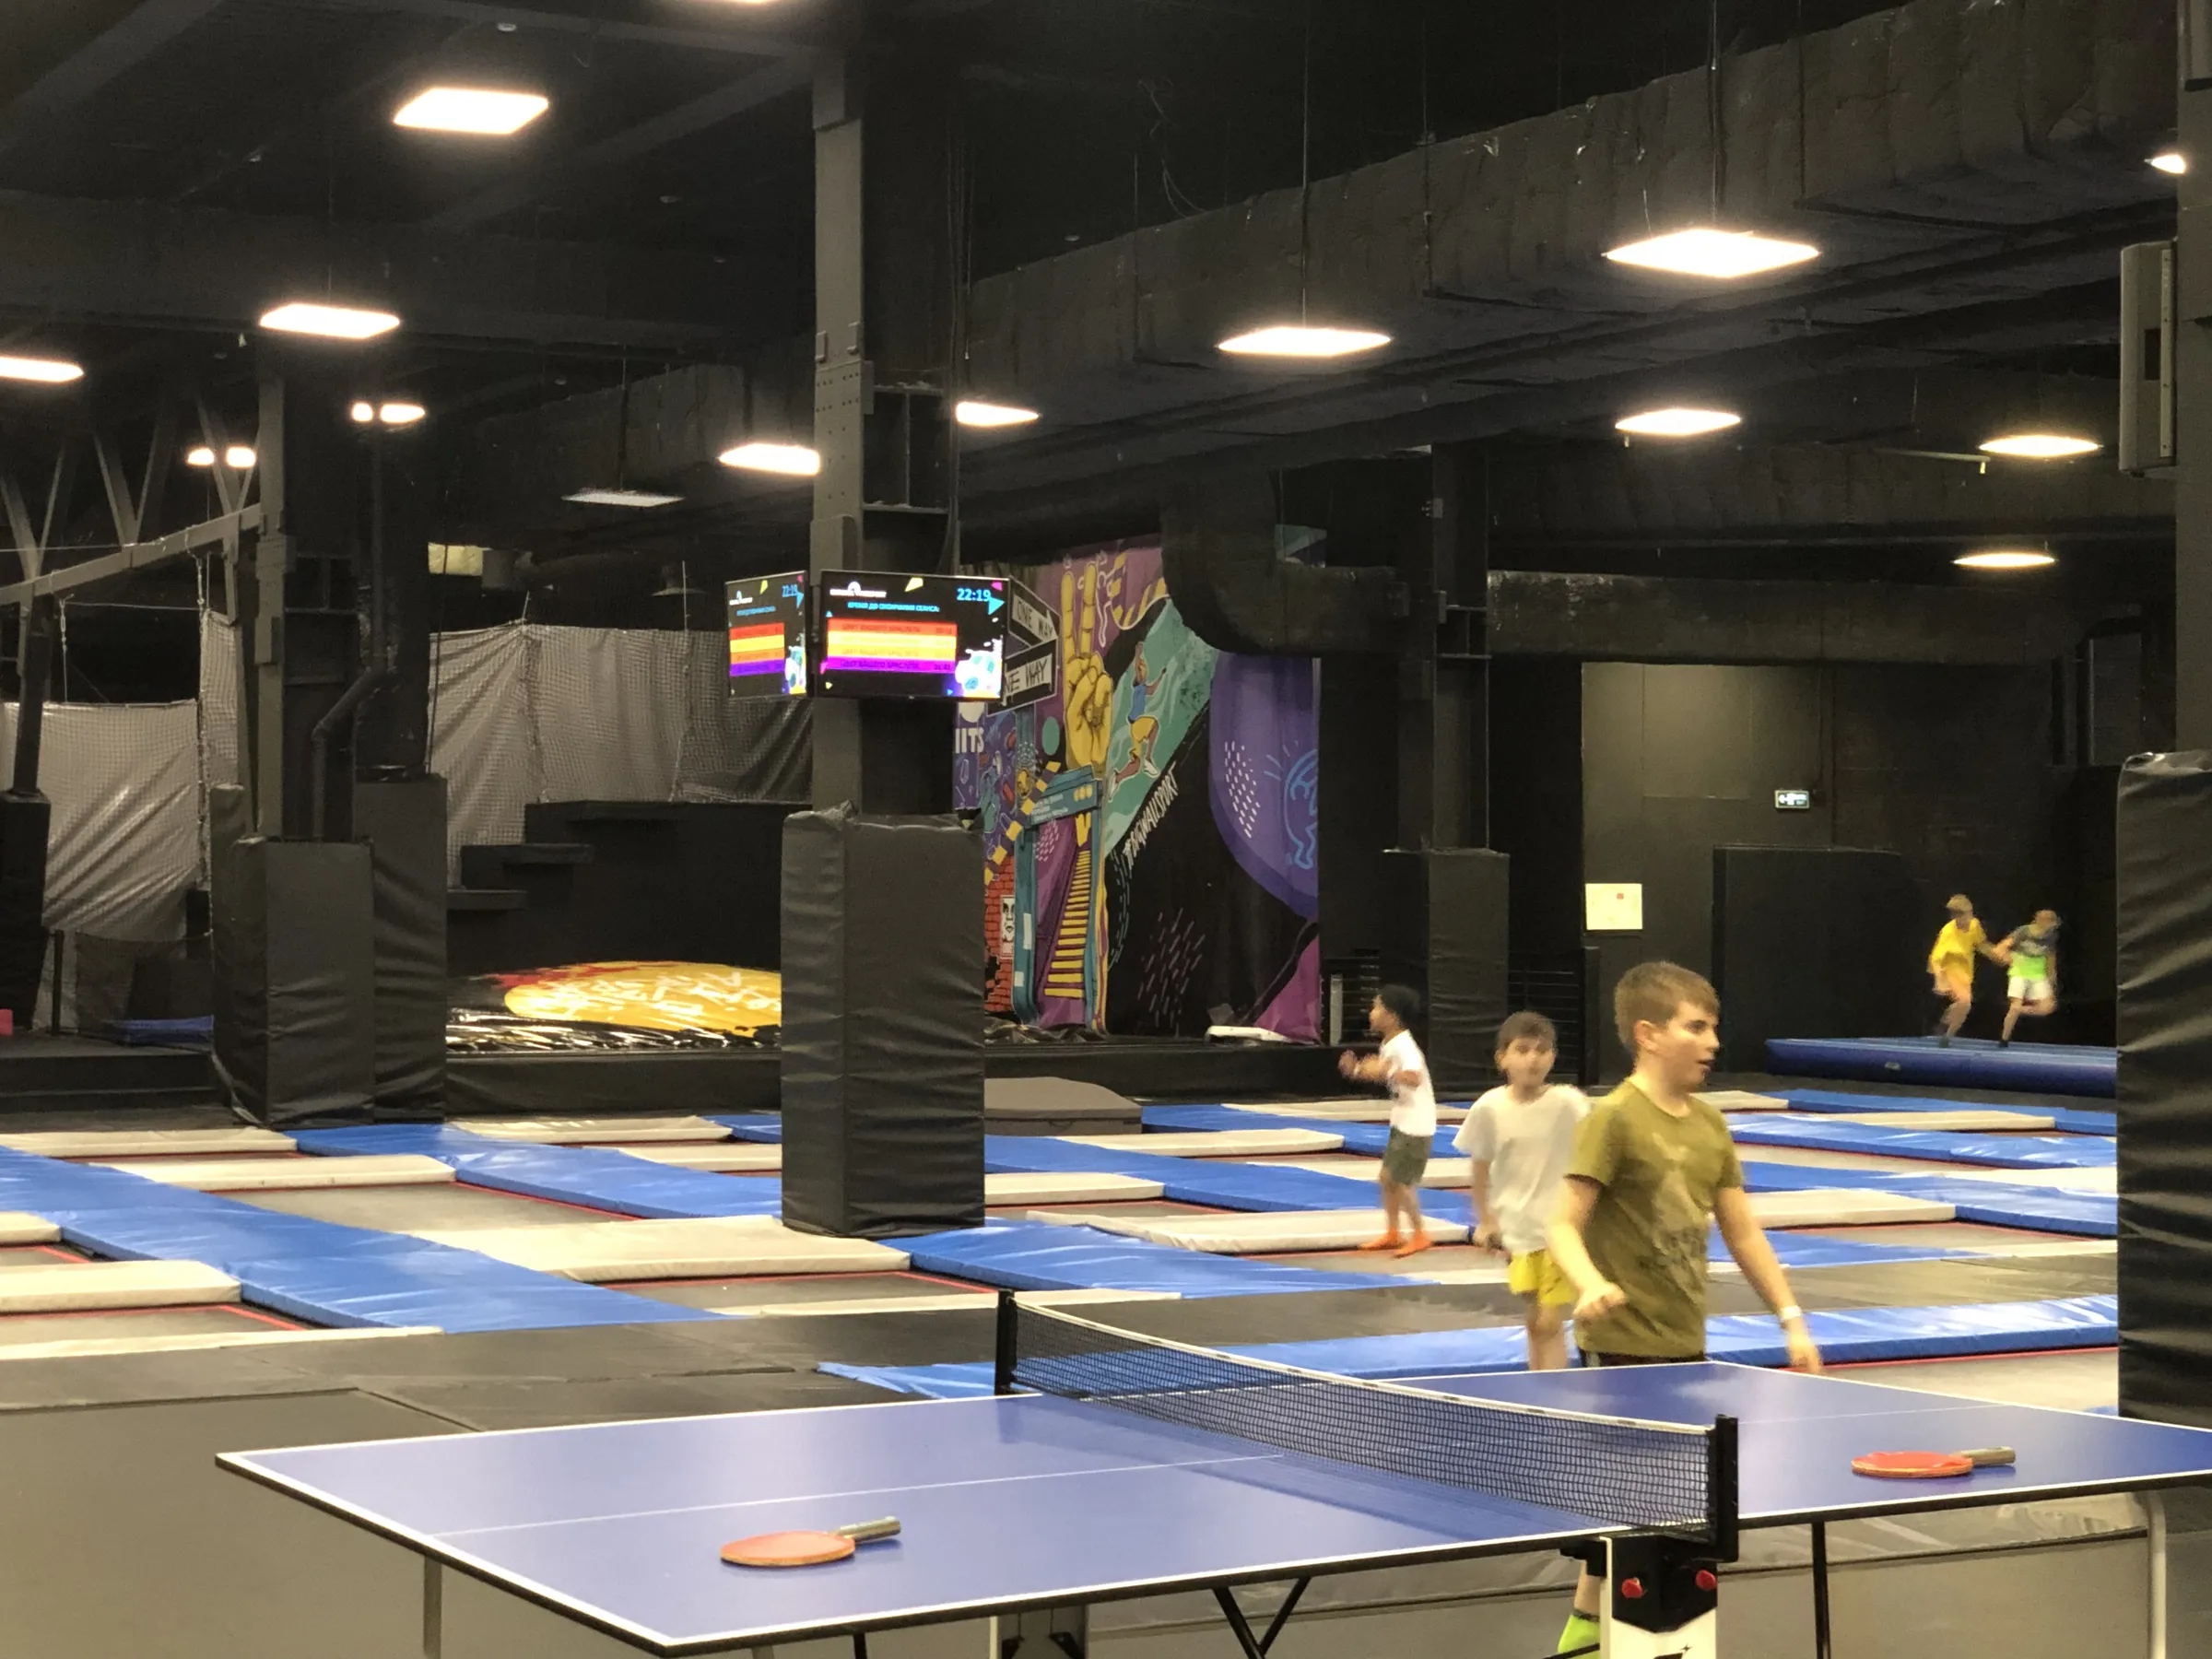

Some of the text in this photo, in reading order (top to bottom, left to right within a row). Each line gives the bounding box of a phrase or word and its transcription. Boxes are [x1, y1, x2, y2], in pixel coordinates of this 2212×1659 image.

[957, 588, 991, 601] 22:19
[1017, 600, 1053, 639] ONE WAY
[1005, 658, 1048, 693] NE WAY
